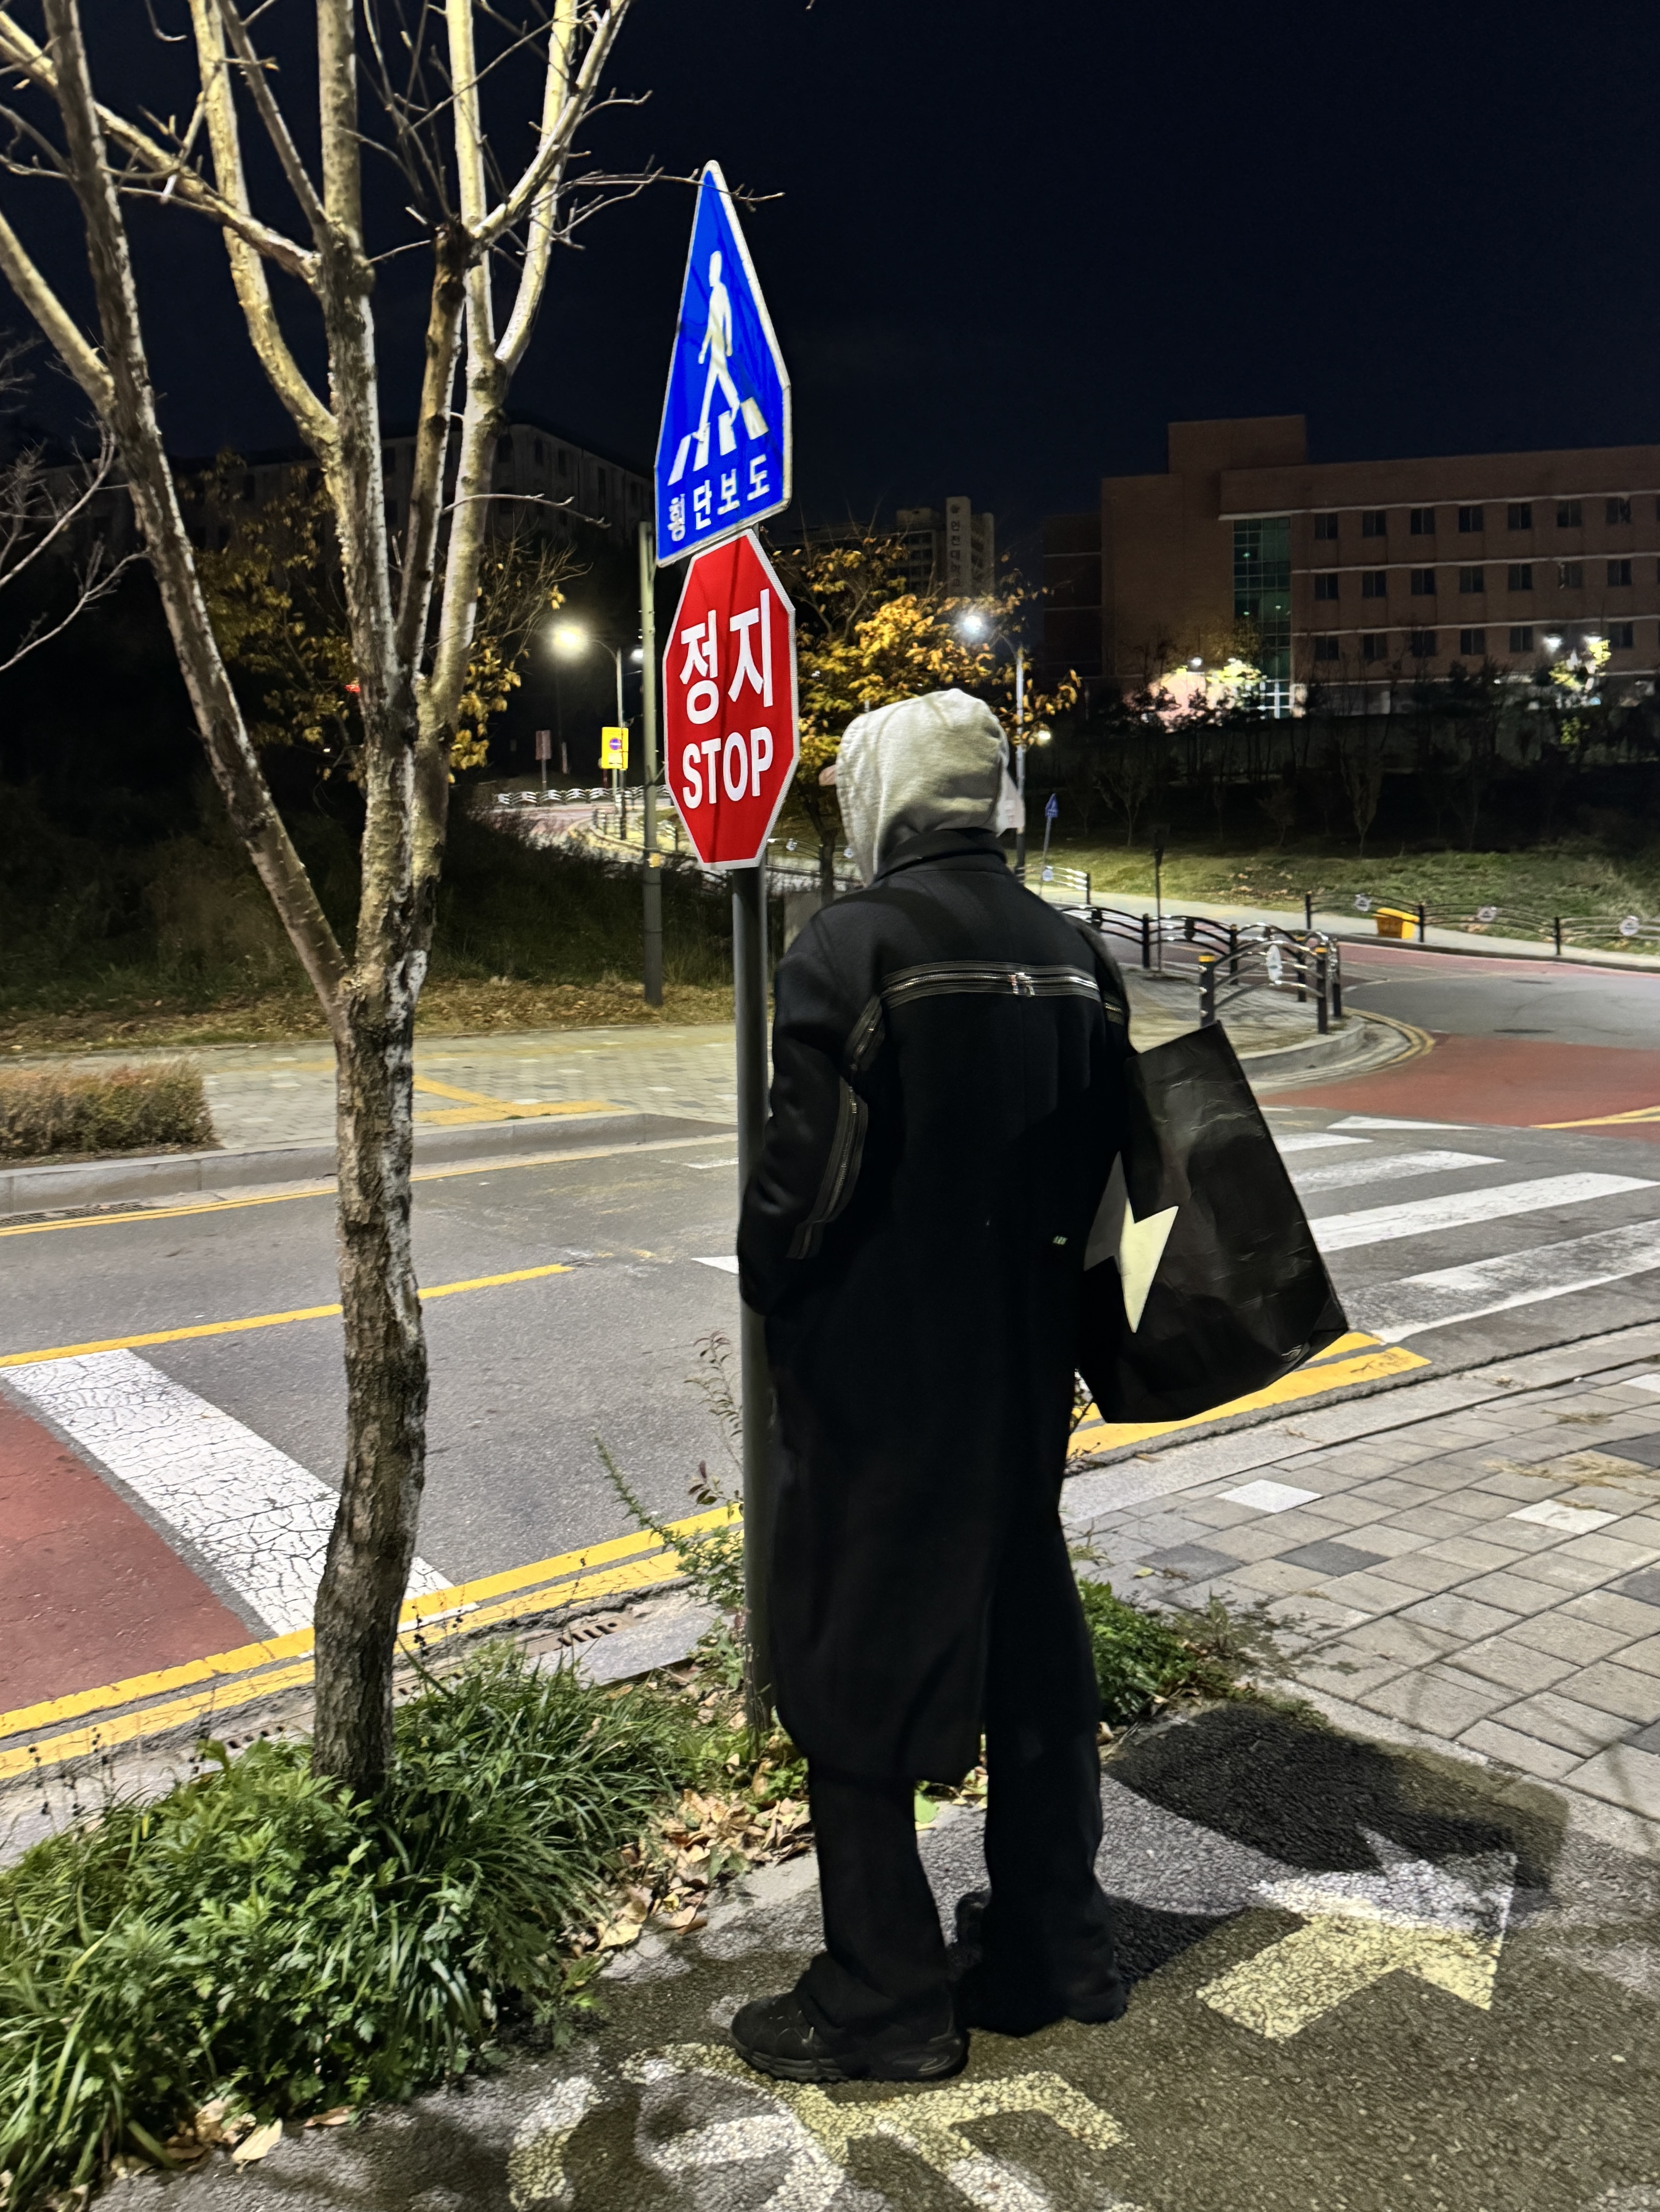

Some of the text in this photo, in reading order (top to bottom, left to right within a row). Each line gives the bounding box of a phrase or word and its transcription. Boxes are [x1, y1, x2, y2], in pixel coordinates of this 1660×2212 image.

[667, 454, 770, 542] 횡단보도
[679, 588, 773, 725] 정지
[682, 726, 773, 809] STOP
